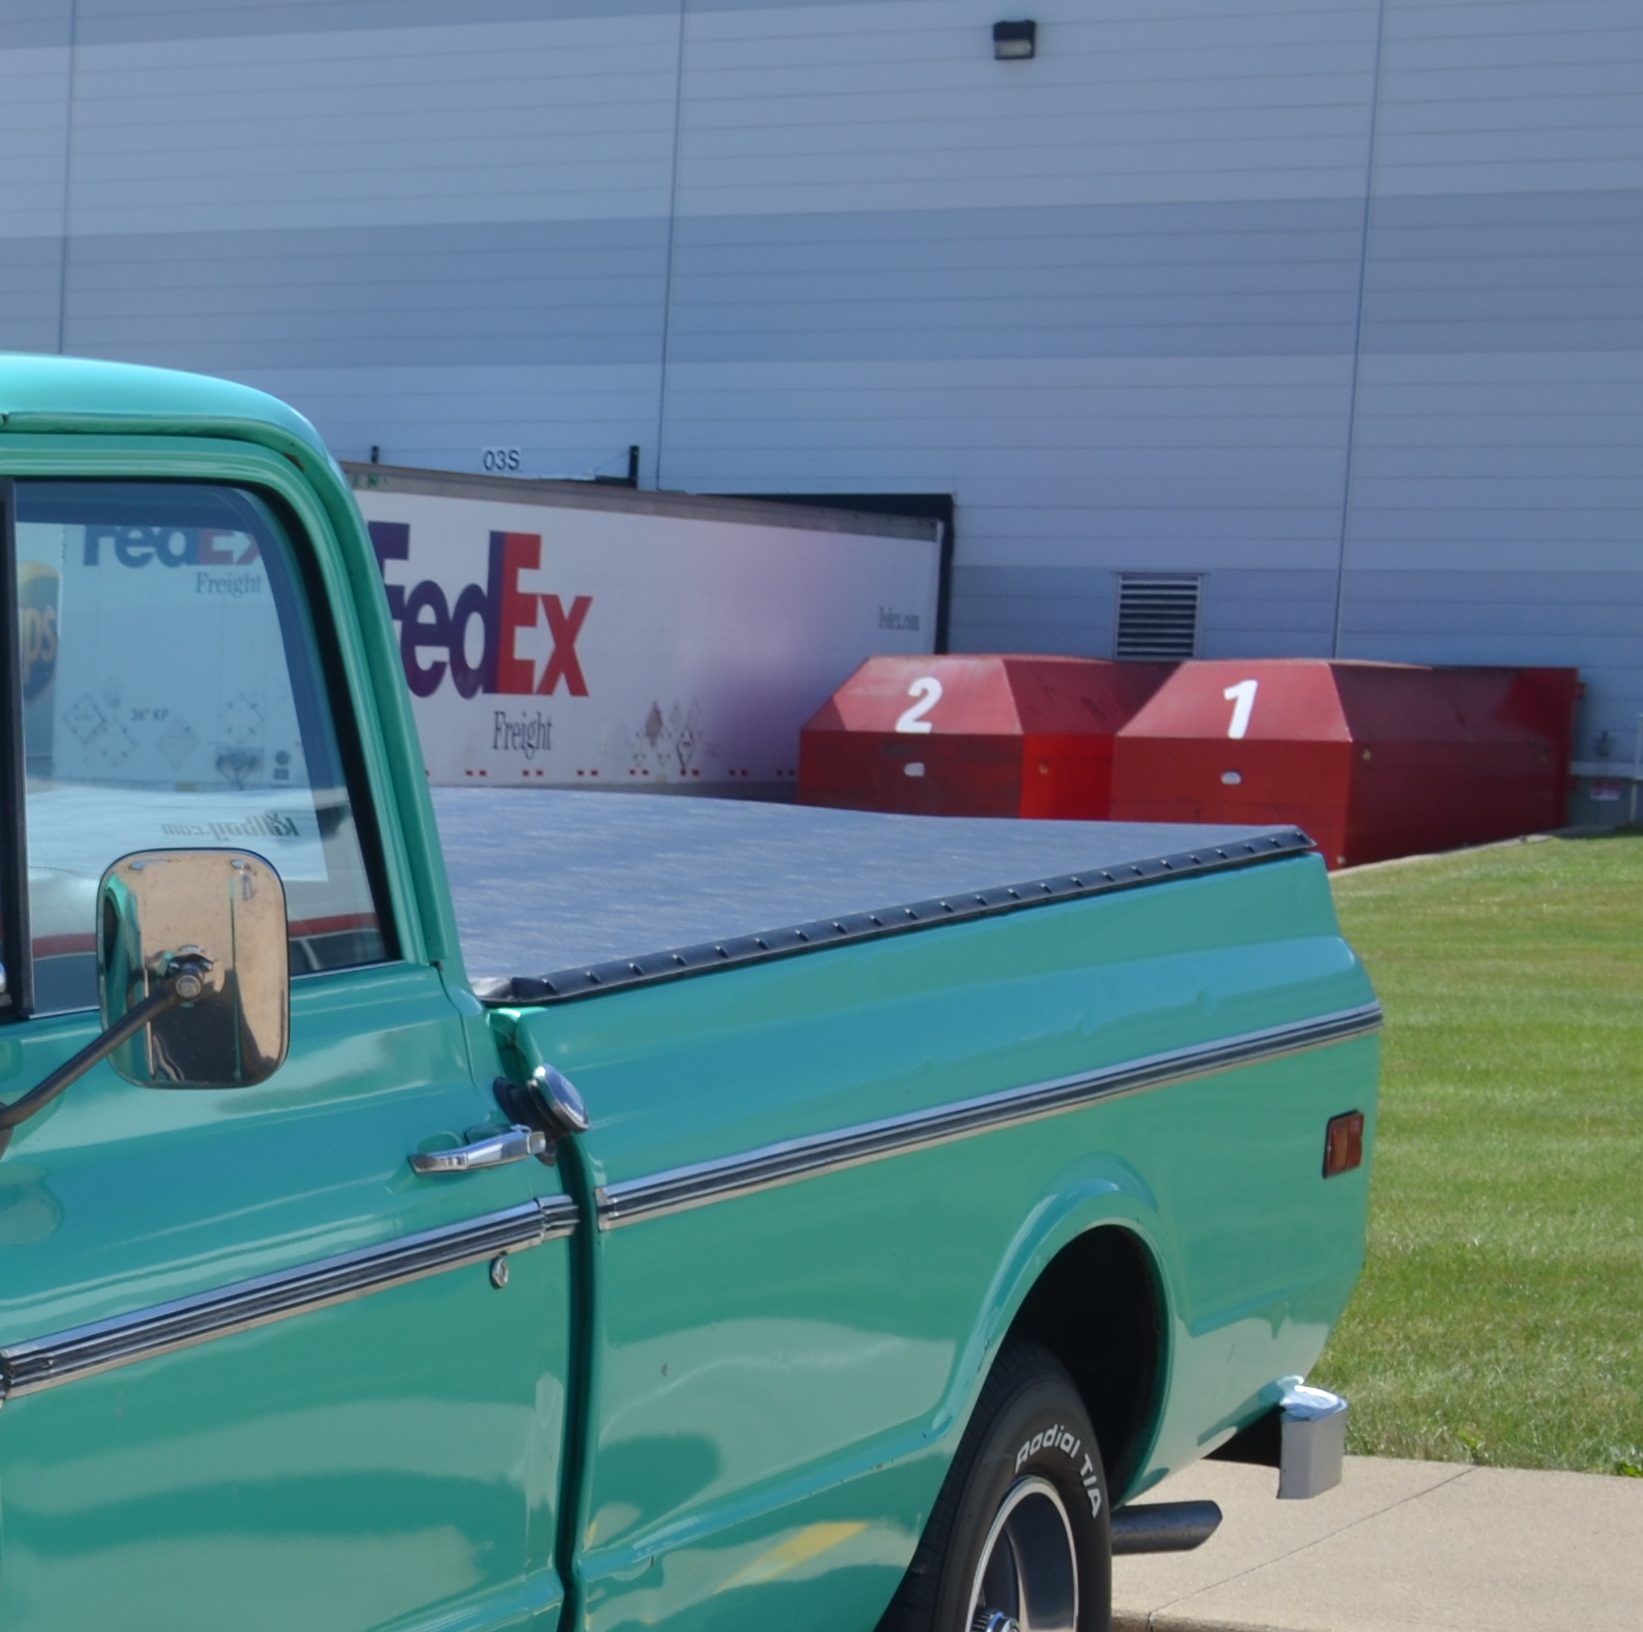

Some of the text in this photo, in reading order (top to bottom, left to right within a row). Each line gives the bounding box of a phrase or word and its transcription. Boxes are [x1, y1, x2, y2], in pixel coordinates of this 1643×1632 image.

[483, 449, 520, 471] 03S
[195, 571, 262, 597] Freight
[368, 520, 594, 700] FedEx
[895, 676, 943, 733] 2
[1223, 679, 1258, 739] 1
[492, 710, 553, 759] Freight
[1015, 1424, 1102, 1519] Radial T/A
